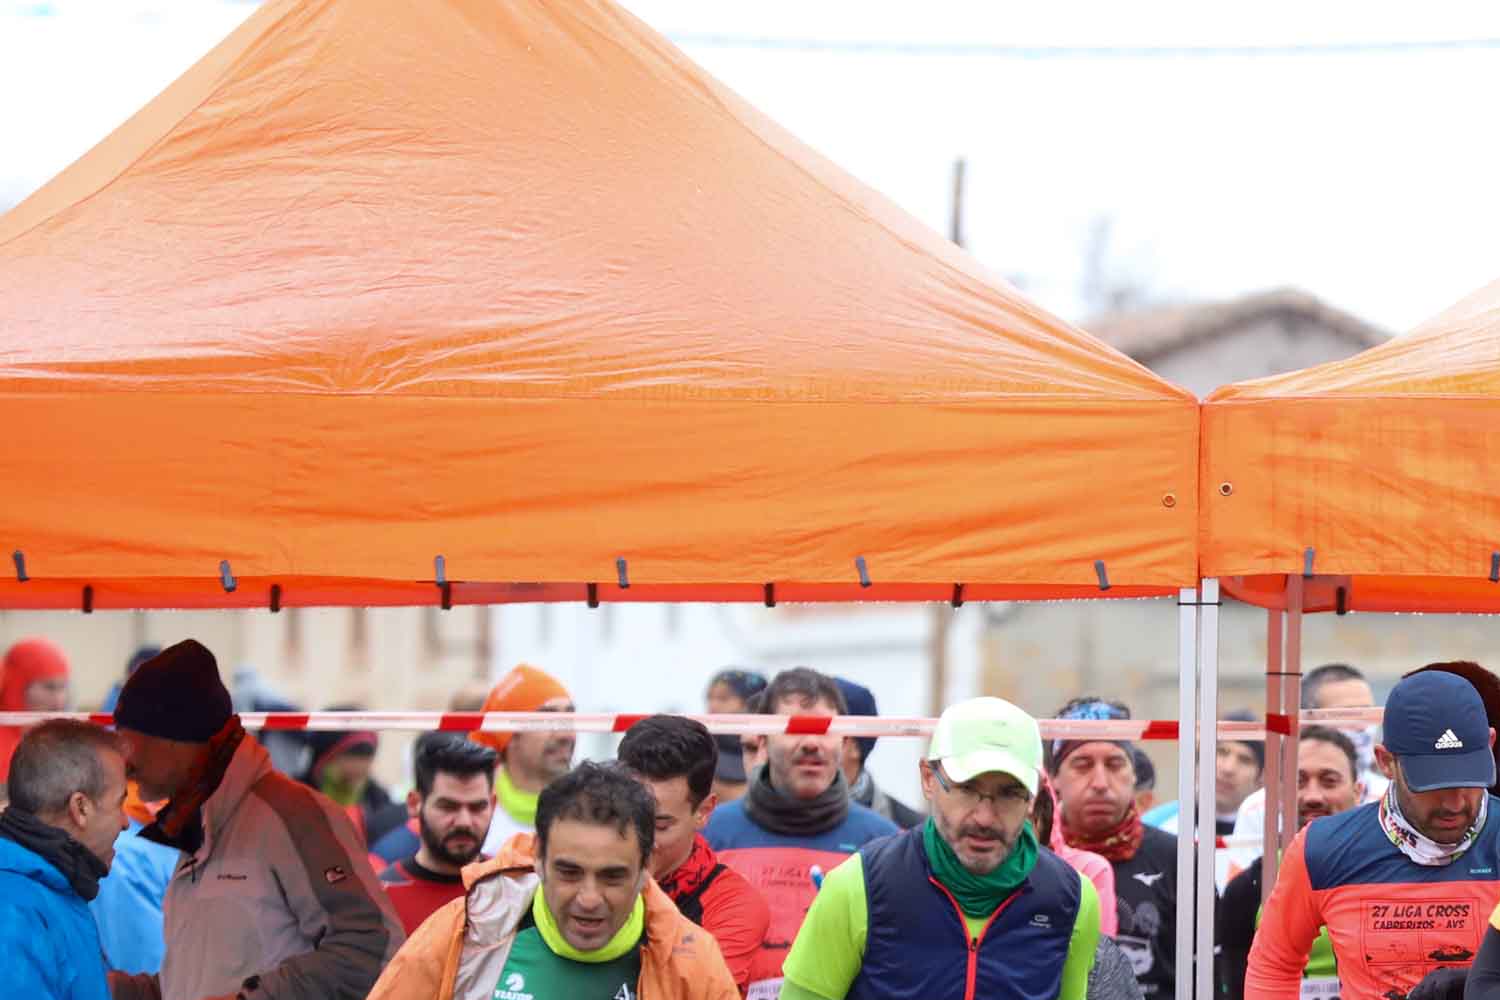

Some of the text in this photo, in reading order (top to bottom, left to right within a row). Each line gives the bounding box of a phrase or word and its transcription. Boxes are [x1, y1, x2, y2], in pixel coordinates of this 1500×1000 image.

[1435, 741, 1463, 749] adidas
[1372, 904, 1470, 918] 27 LIGA CROSS
[1373, 920, 1435, 930] CABRERIZOS
[1445, 919, 1465, 929] AVS
